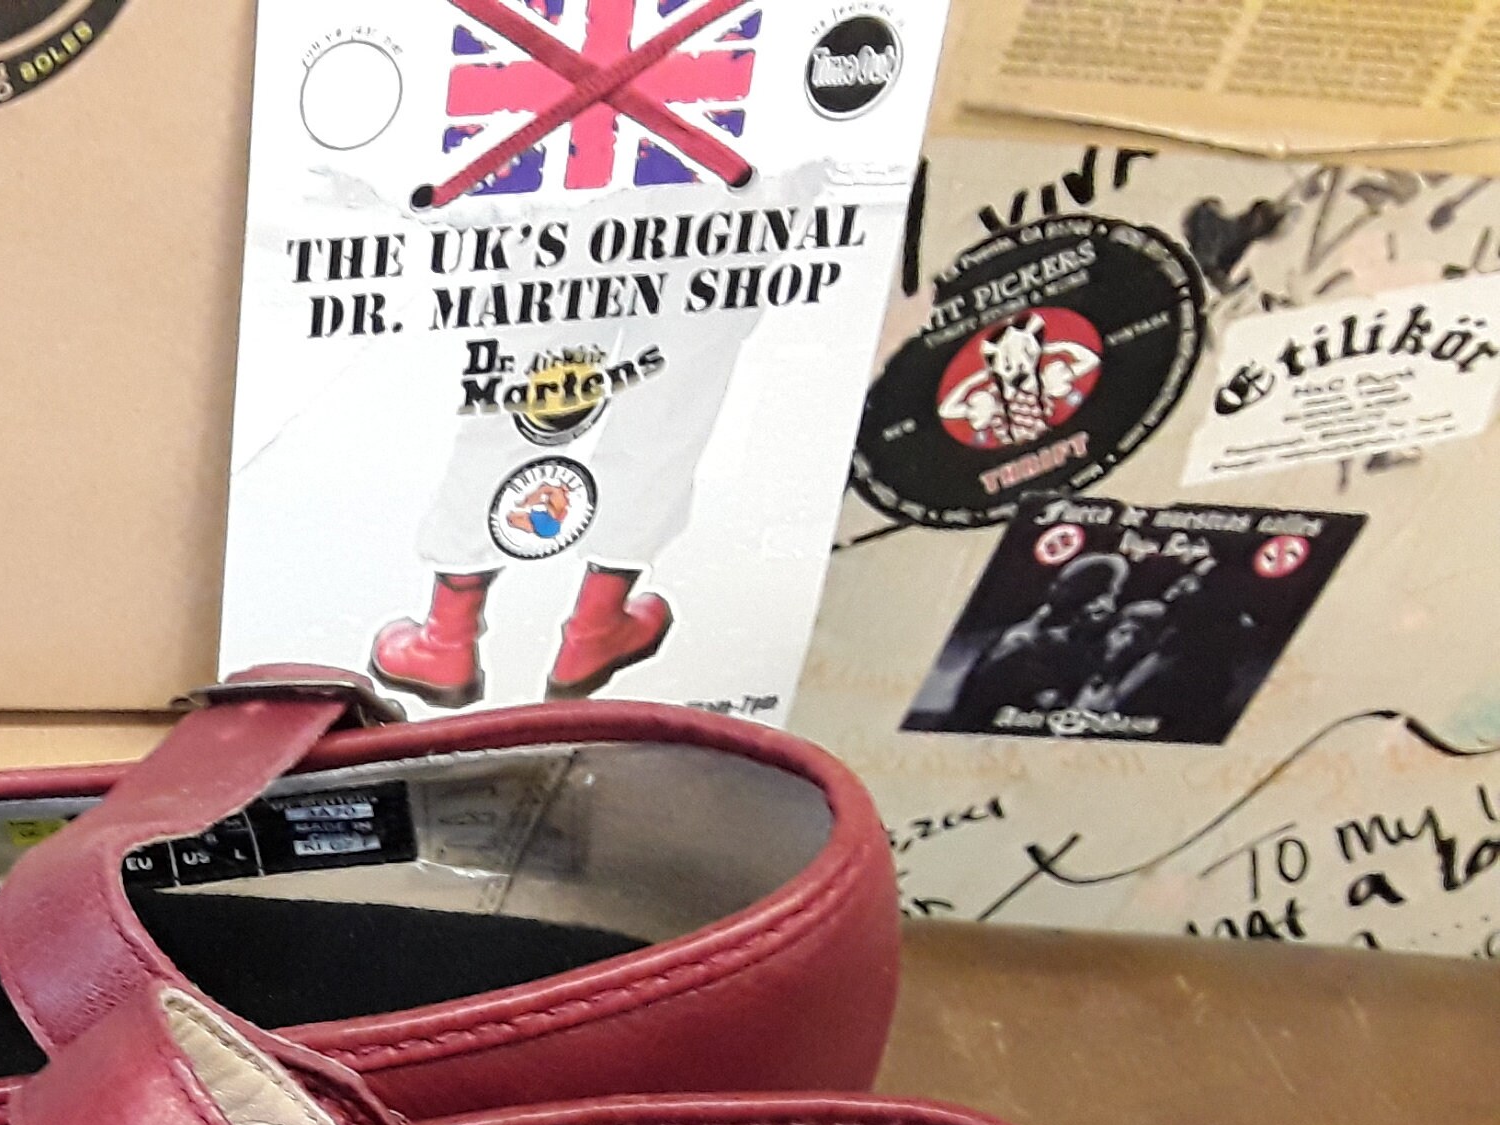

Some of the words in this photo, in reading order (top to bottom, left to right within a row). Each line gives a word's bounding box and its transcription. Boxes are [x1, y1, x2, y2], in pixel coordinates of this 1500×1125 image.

[286, 232, 407, 284] THE
[429, 220, 570, 275] UK'S
[588, 204, 867, 265] ORIGINAL
[973, 239, 1098, 312] PICKERS
[306, 292, 405, 339] DR.
[428, 272, 669, 331] MARTEN
[684, 262, 843, 314] SHOP
[457, 345, 668, 416] Martens
[125, 856, 154, 871] EU
